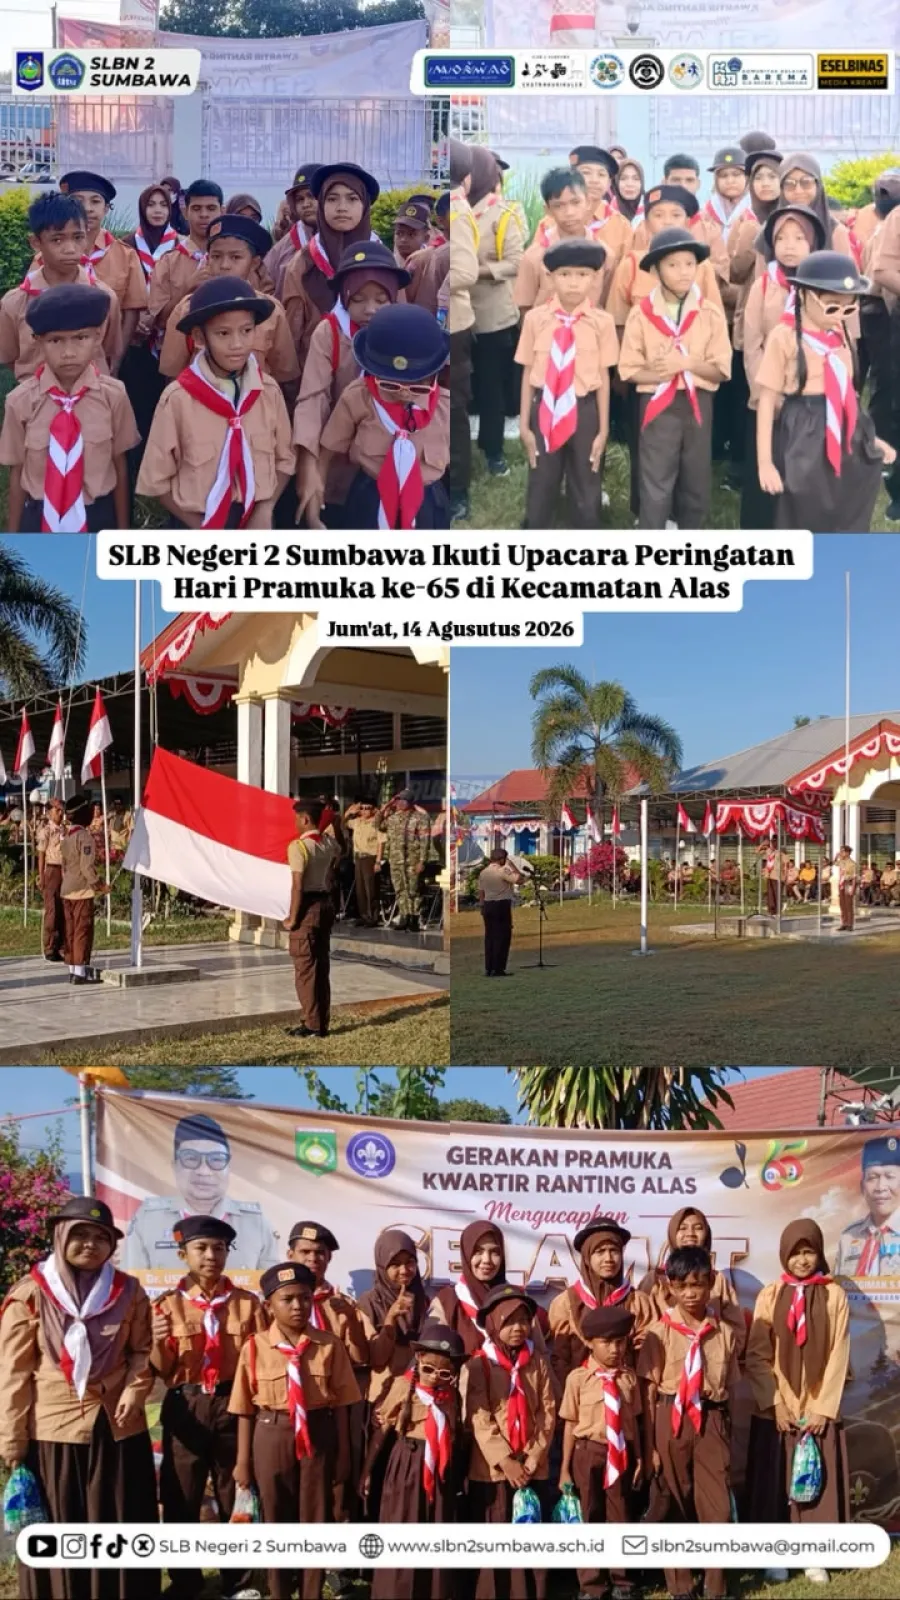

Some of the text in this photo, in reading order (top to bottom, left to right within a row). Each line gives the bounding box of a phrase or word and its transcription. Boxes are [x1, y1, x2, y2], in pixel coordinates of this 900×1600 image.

[446, 1145, 673, 1171] GERAKAN PRAMUKA
[423, 1172, 697, 1195] KWARTIR RANTING ALAS
[484, 1199, 629, 1231] Mengucapkan
